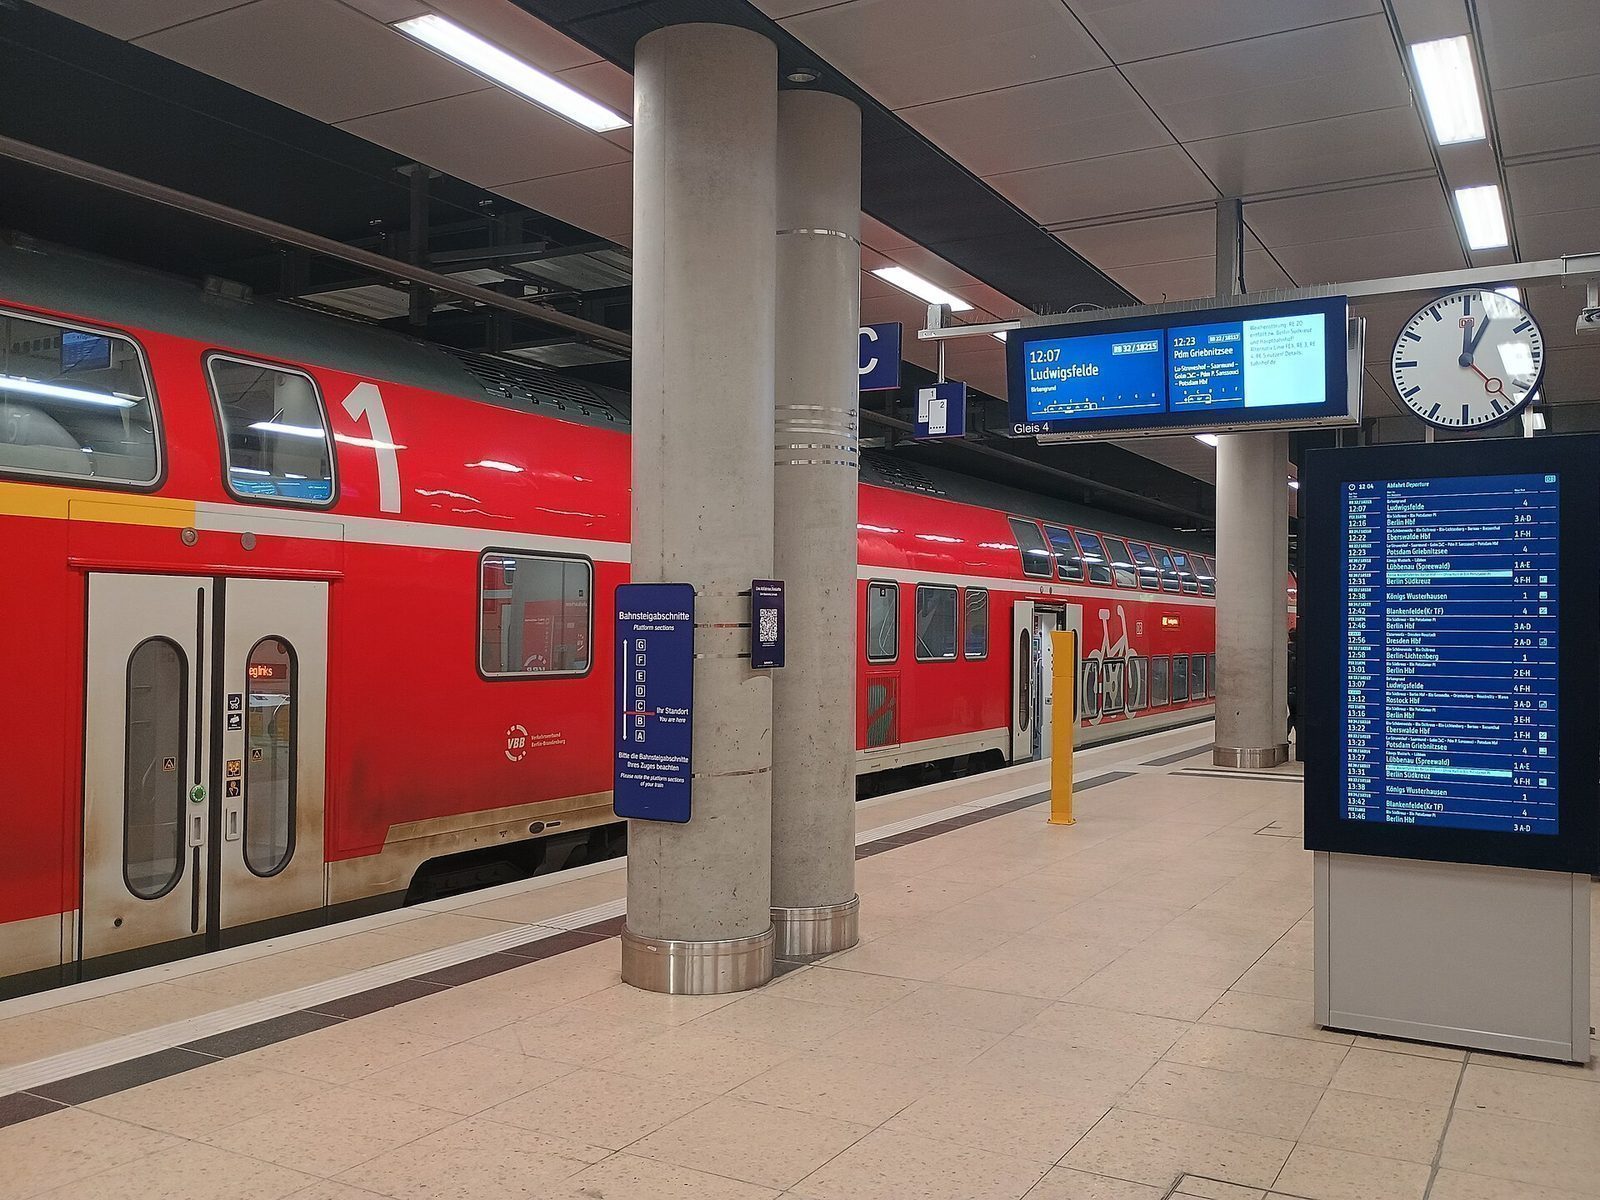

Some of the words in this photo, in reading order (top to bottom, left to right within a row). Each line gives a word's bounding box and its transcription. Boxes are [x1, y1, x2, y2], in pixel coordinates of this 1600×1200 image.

[1174, 337, 1195, 347] 12:23
[1030, 349, 1061, 363] 12:07
[1174, 350, 1189, 358] Pdm
[1190, 348, 1233, 356] Griebnitzsee
[1031, 363, 1099, 381] Ludwigsfelde
[1014, 423, 1040, 434] Gleis
[1042, 422, 1049, 432] 4
[341, 381, 401, 513] 1
[1387, 504, 1425, 512] Ludwigsfelde
[1416, 562, 1450, 571] (Spreewald)
[1386, 593, 1405, 601] Königs
[619, 611, 690, 622] Bahnsteigabschnitte
[638, 641, 644, 649] G
[638, 656, 644, 664] F
[1386, 652, 1439, 661] Berlin-Lichtenberg
[638, 672, 644, 680] E
[1386, 682, 1424, 690] Ludwigsfelde
[638, 687, 644, 695] D
[638, 702, 643, 710] C
[665, 707, 688, 715] Standort
[638, 717, 643, 725] B
[1386, 726, 1418, 734] Eberswalde
[637, 732, 643, 740] A
[508, 737, 525, 749] VBB
[1386, 741, 1411, 749] Potsdam
[1411, 742, 1448, 750] Griebnitzsee
[639, 753, 688, 763] Bahnsteigabschnitte
[1415, 757, 1450, 766] (Spreewald)
[640, 762, 655, 770] Zuges
[1348, 768, 1366, 776] 13:31
[1386, 786, 1405, 794] Königs
[1406, 787, 1448, 796] Wusterhausen
[1348, 812, 1366, 820] 13:46
[1404, 816, 1415, 824] Hbf
